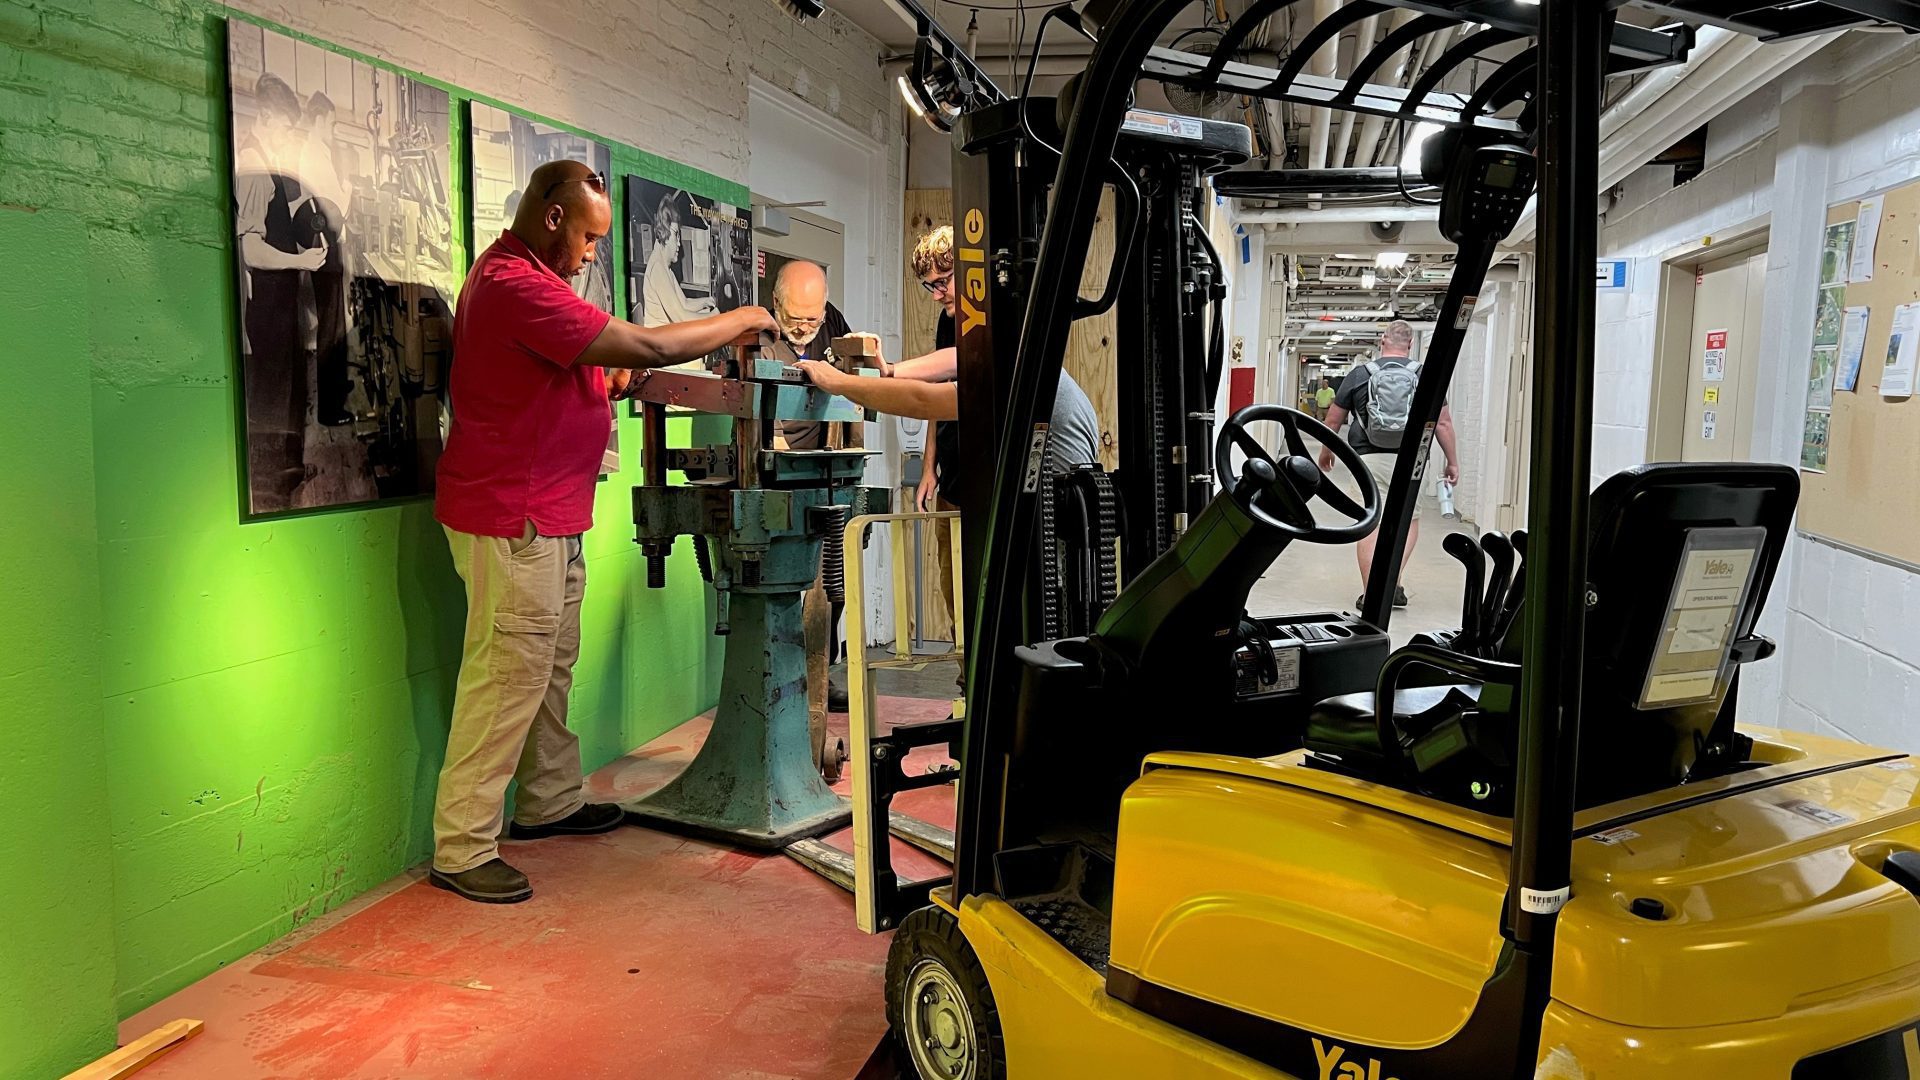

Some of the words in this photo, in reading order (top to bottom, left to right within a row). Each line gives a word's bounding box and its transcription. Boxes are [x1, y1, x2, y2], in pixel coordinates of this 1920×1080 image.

[689, 203, 702, 216] THE
[959, 208, 986, 337] Yale
[1704, 559, 1728, 575] Yale
[1311, 1037, 1400, 1080] Yal
